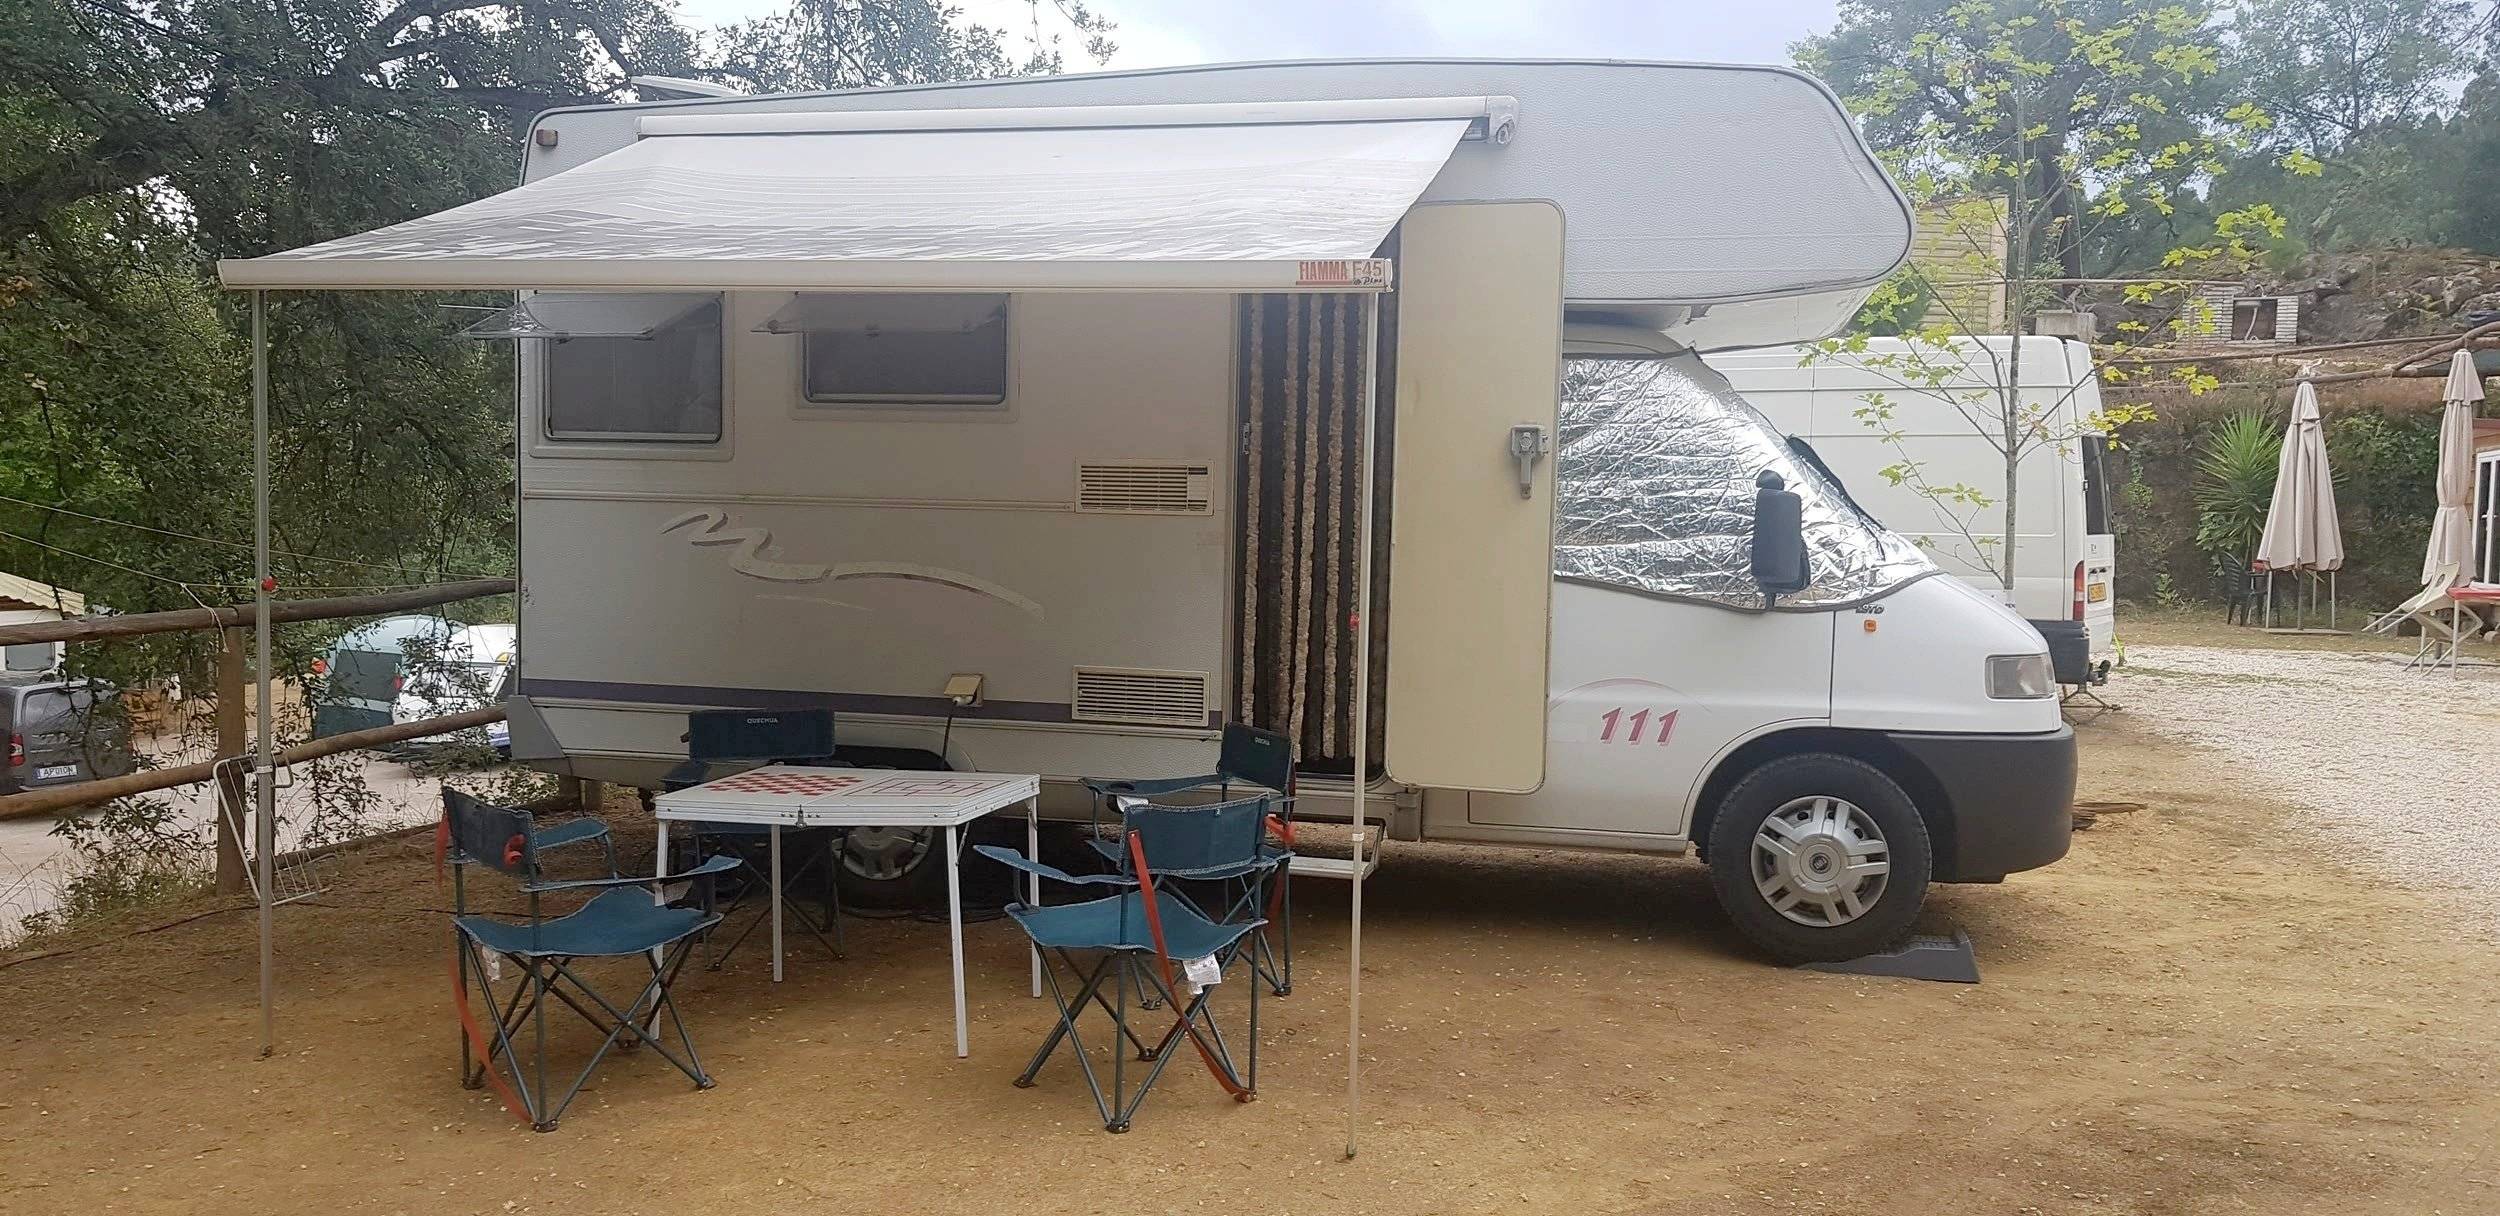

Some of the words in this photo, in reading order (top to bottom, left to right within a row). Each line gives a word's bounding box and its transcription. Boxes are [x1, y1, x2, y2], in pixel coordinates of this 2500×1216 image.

[1299, 261, 1348, 281] FIAMMA
[1352, 260, 1382, 277] F45
[1600, 707, 1680, 746] 111
